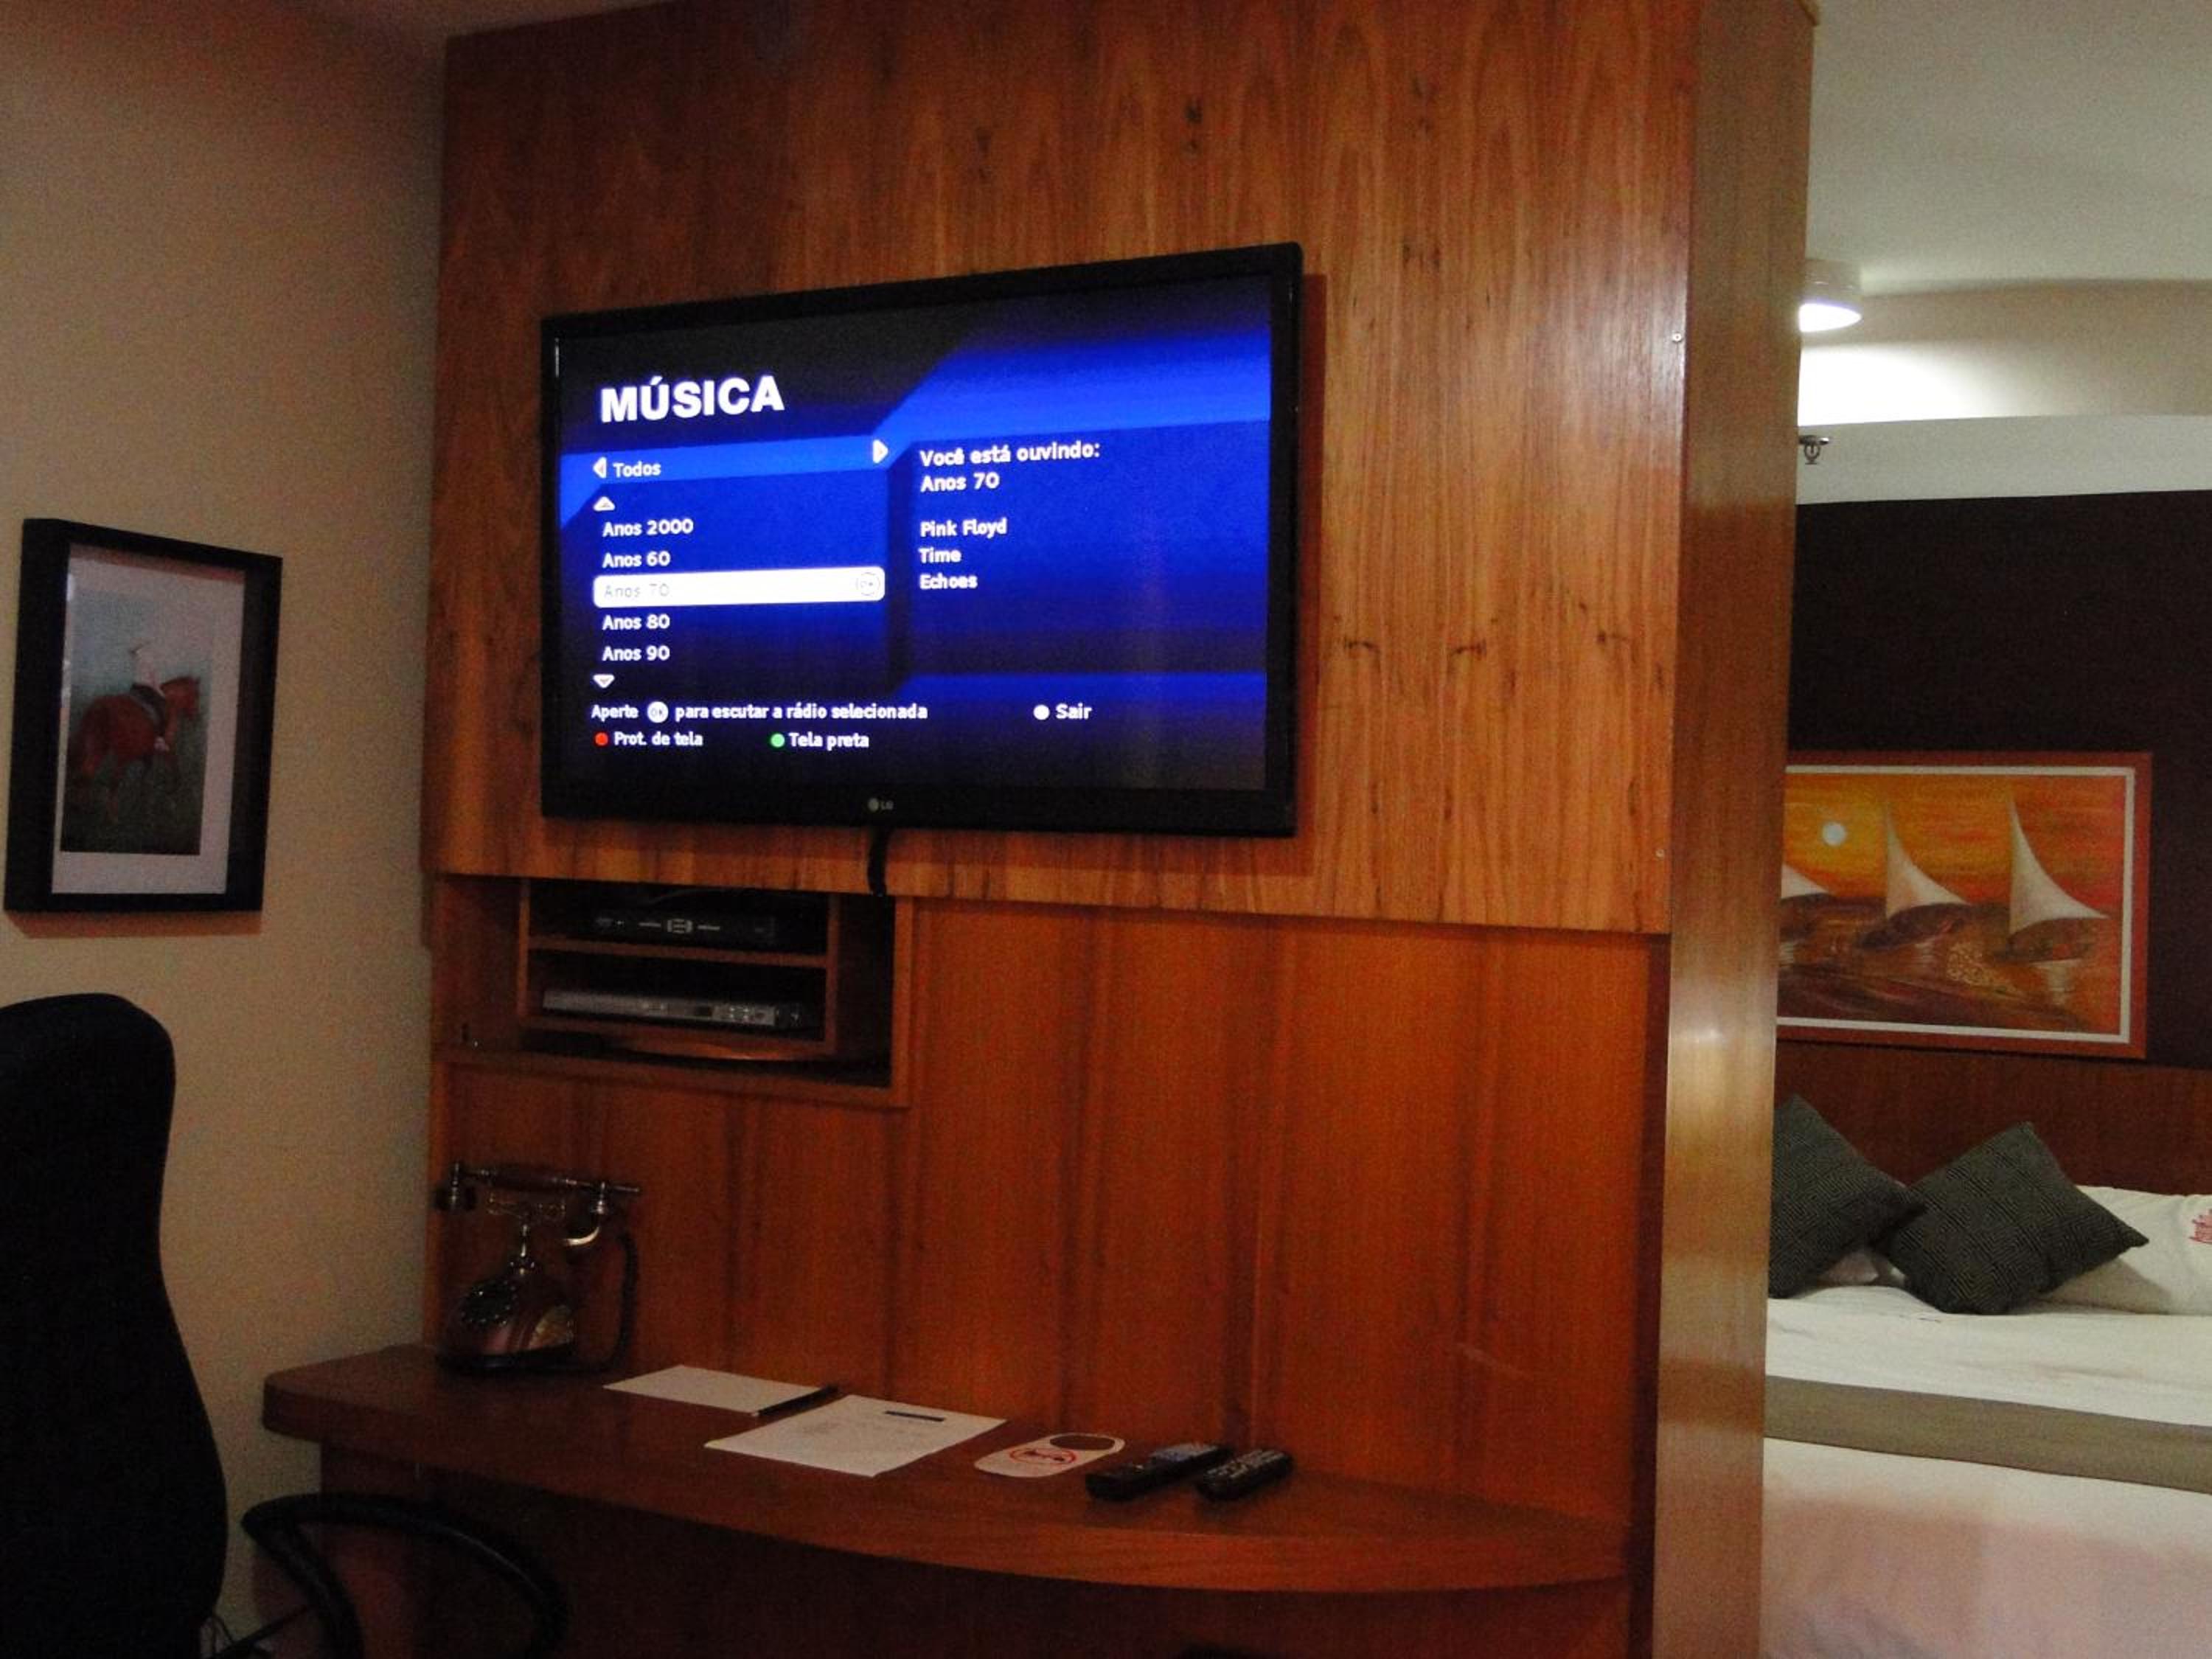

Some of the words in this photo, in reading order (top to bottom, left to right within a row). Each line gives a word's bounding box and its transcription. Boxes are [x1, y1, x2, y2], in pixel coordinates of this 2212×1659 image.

[600, 376, 785, 422] MÚSICA
[920, 450, 964, 467] Você
[970, 446, 1011, 465] está
[1017, 441, 1100, 462] ouvindo:
[613, 460, 661, 478] Todos
[920, 476, 966, 493] Anos
[974, 472, 1000, 490] 70
[602, 521, 642, 538] Anos
[647, 518, 694, 535] 2000
[920, 521, 958, 538] Pink
[962, 518, 1007, 538] Floyd
[602, 552, 642, 568] Anos
[647, 551, 671, 566] 60
[919, 548, 961, 563] Time
[919, 573, 978, 590] Echoes
[605, 585, 641, 598] Anos
[602, 615, 642, 631] Anos
[646, 613, 671, 629] 80
[602, 646, 642, 661] Anos
[646, 645, 671, 661] 90
[591, 704, 639, 722] Aperte
[675, 706, 709, 722] para
[712, 703, 769, 719] escutar
[772, 706, 782, 719] a
[786, 701, 827, 719] rádio
[831, 702, 928, 719] selecionada
[1055, 703, 1092, 720] Sair
[613, 731, 647, 746] Prot.
[651, 731, 670, 745] de
[673, 731, 703, 746] tela
[788, 731, 823, 747] Tela
[827, 732, 870, 751] preta
